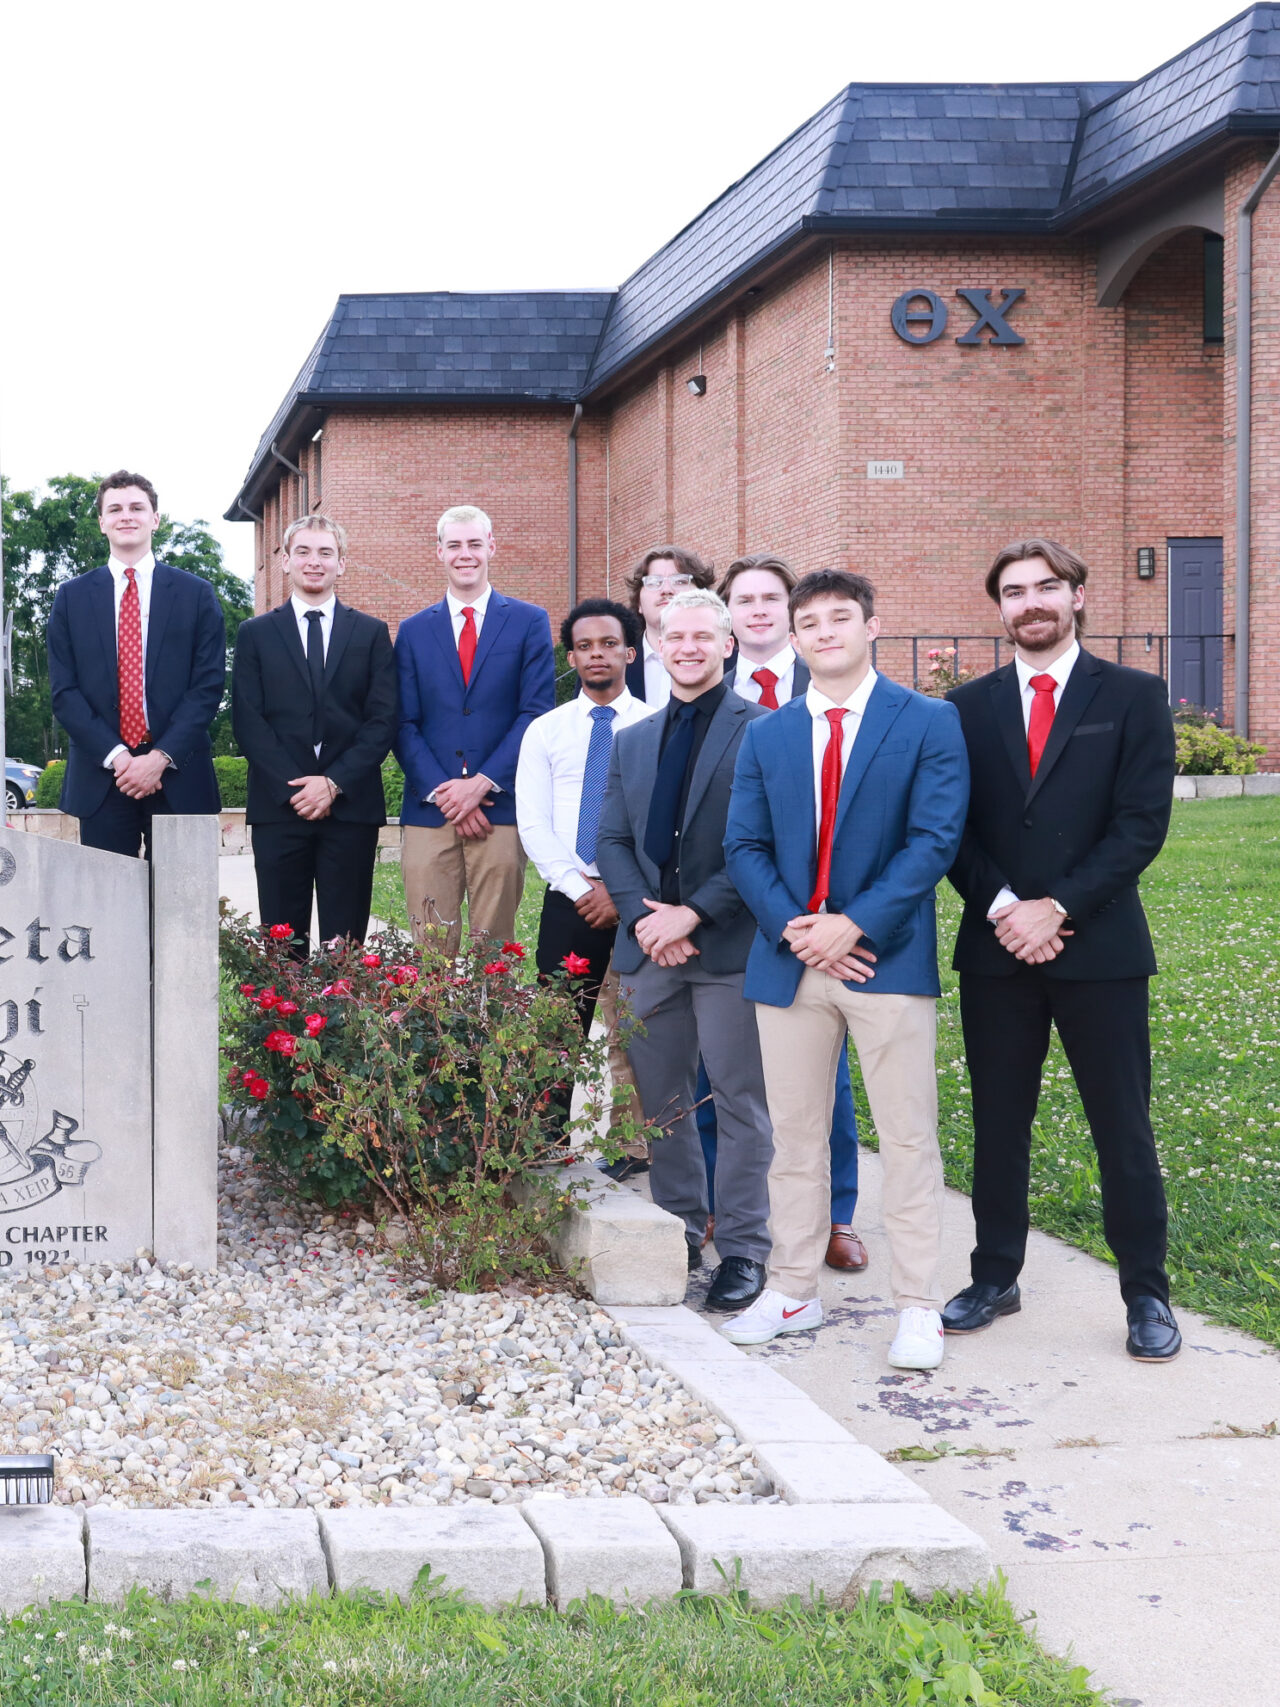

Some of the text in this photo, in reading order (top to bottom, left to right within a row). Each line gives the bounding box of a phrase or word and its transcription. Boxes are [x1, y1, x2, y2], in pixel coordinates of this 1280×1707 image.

[874, 465, 897, 475] 1440
[58, 1163, 74, 1179] 56
[5, 1225, 108, 1244] CHAPTER
